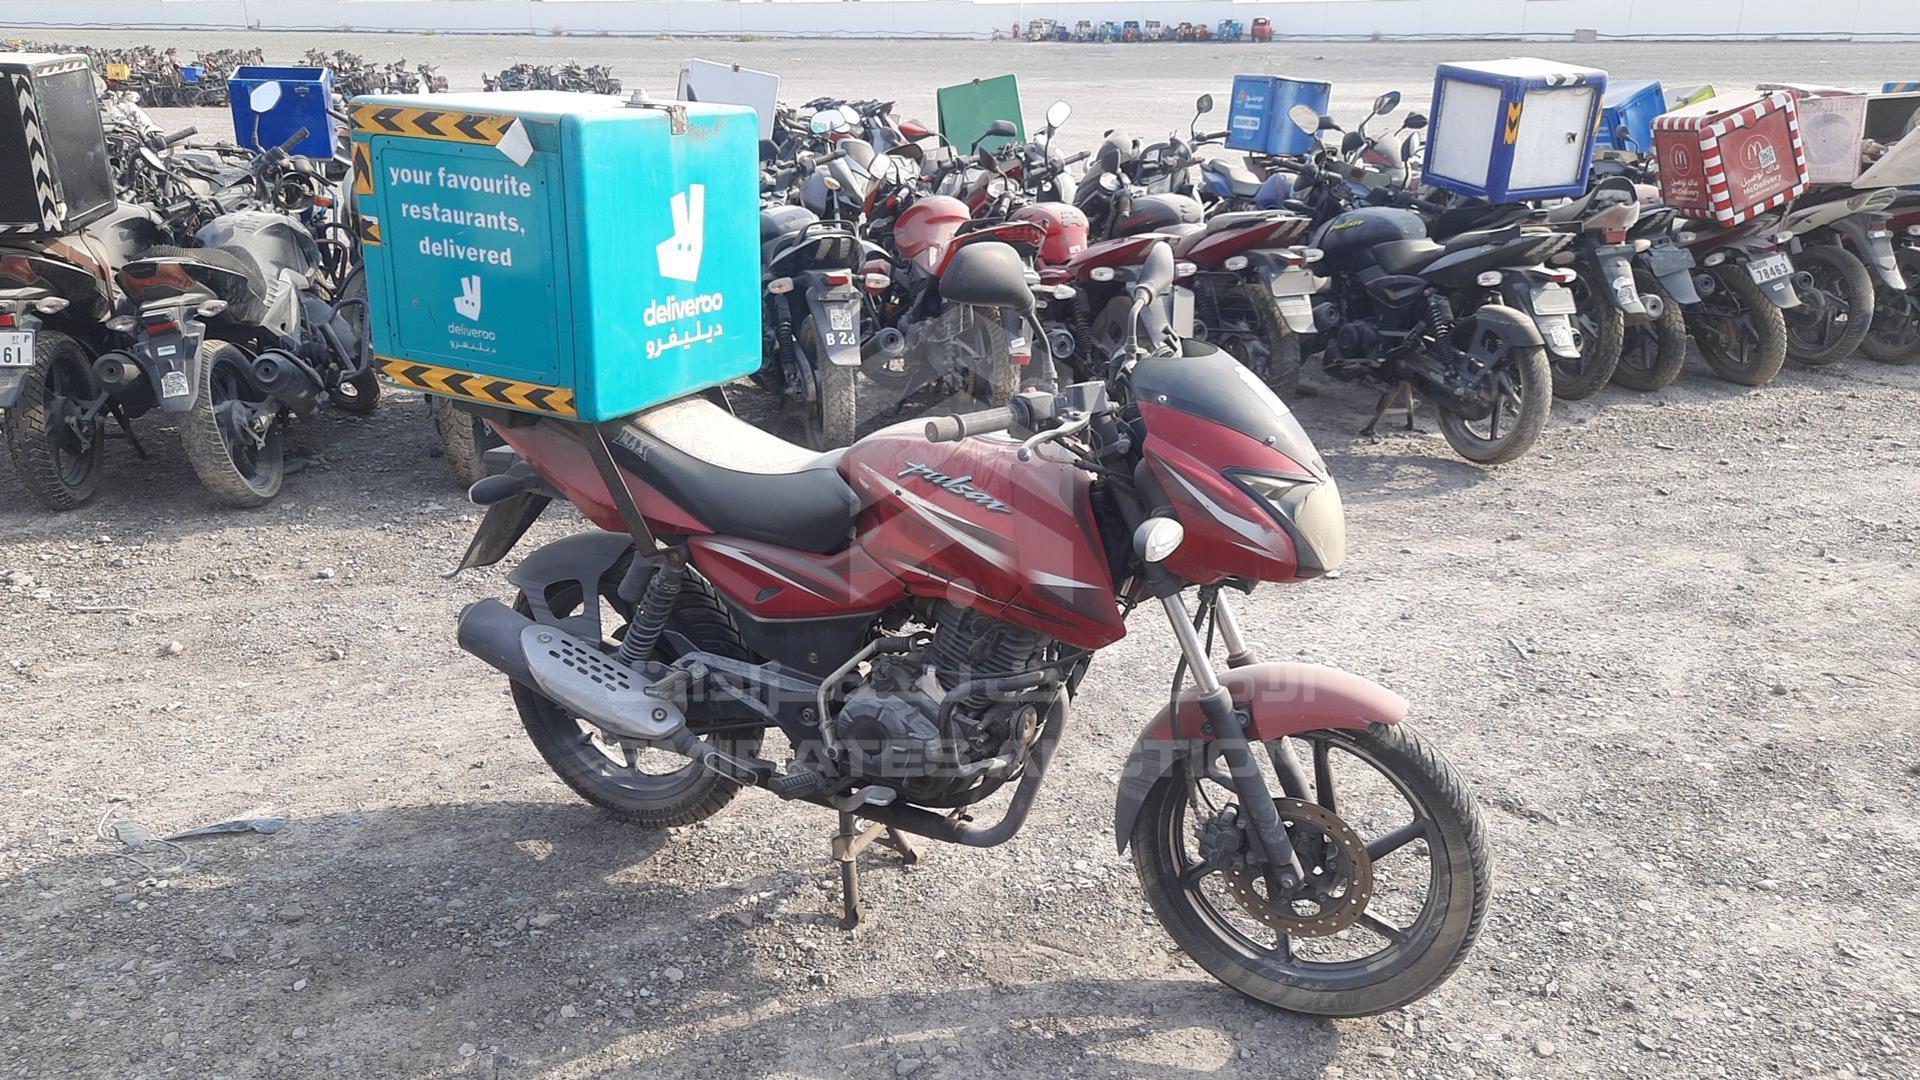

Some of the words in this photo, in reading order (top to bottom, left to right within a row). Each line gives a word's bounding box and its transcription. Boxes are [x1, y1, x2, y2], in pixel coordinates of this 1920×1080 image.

[389, 166, 432, 186] your
[437, 167, 532, 198] favourite
[1743, 173, 1782, 196] McDelivery
[401, 202, 526, 237] restaurants,
[419, 236, 513, 267] delivered
[1755, 263, 1789, 281] 78463
[643, 292, 723, 327] deliveroo
[448, 322, 496, 341] deliveroo
[645, 320, 723, 360] ديليفرو
[825, 332, 836, 346] B
